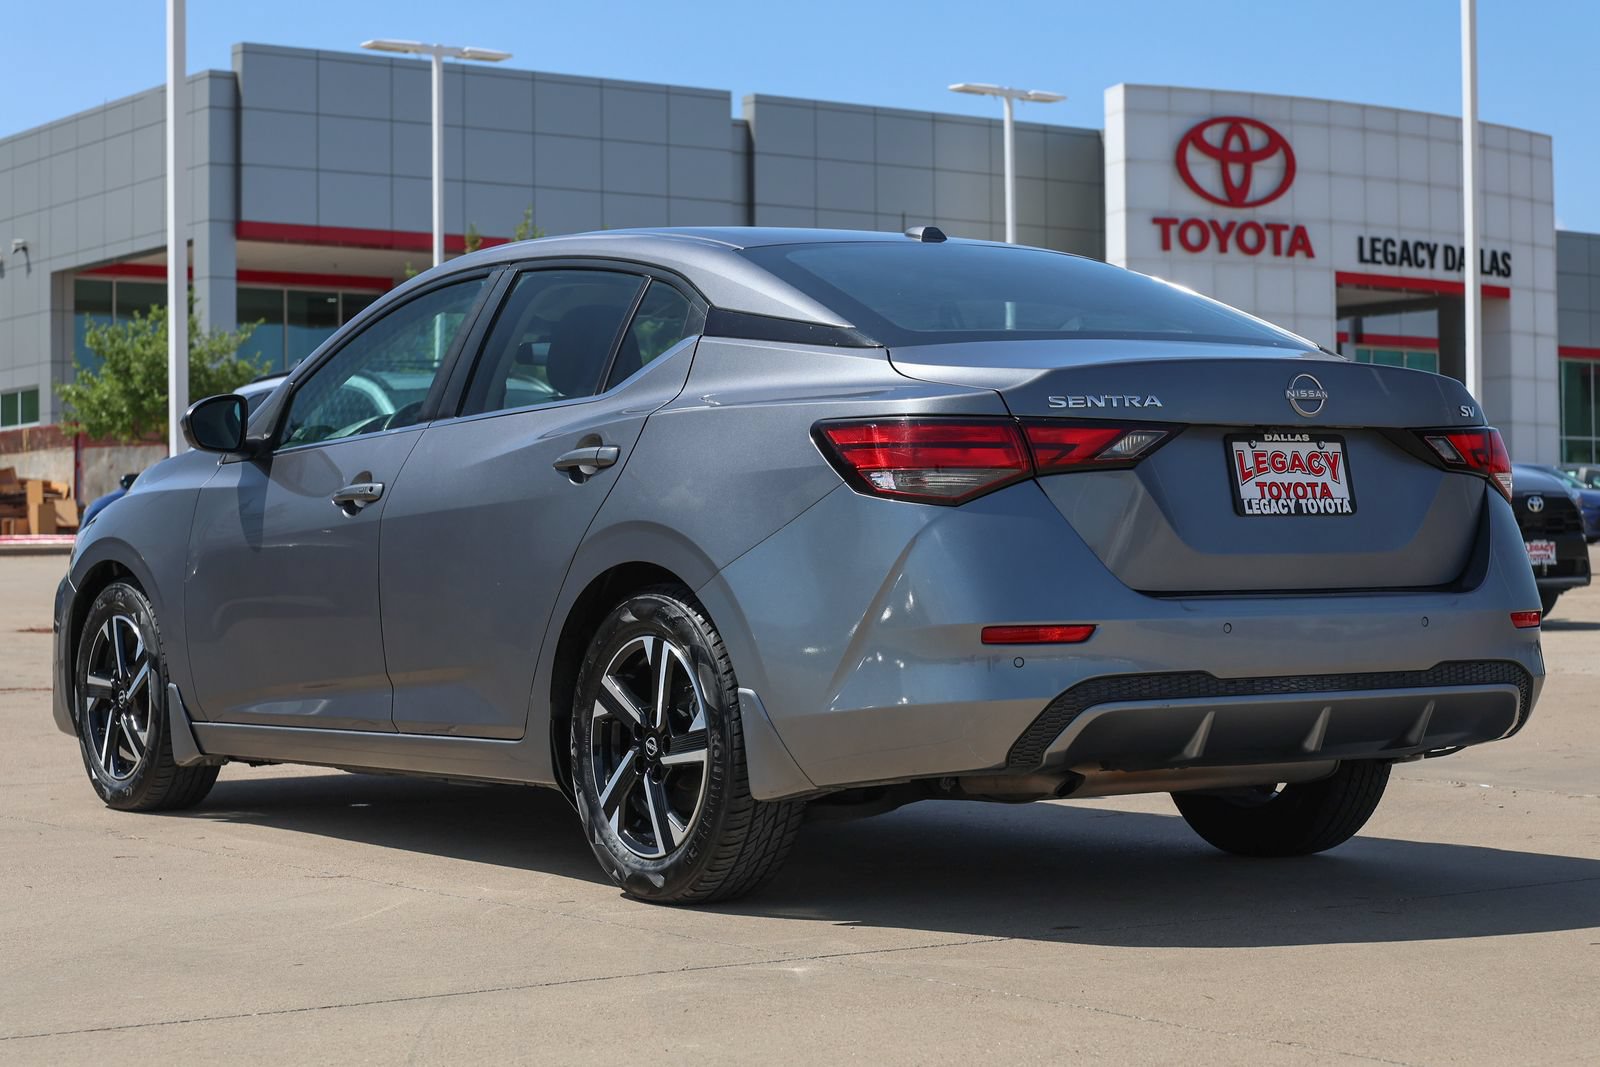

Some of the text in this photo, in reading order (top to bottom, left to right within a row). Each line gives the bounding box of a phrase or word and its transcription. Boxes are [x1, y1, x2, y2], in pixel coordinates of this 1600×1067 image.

[1152, 217, 1315, 258] TOYOTA
[1358, 236, 1511, 277] LEGACY DALAS
[1048, 394, 1163, 408] SENTRA
[1286, 389, 1328, 399] NISSAN
[1264, 434, 1310, 442] DALLAS
[1236, 450, 1341, 485] LEGACY
[1255, 482, 1333, 500] TOYOTA
[1243, 499, 1352, 514] LEGACY TOYOTA
